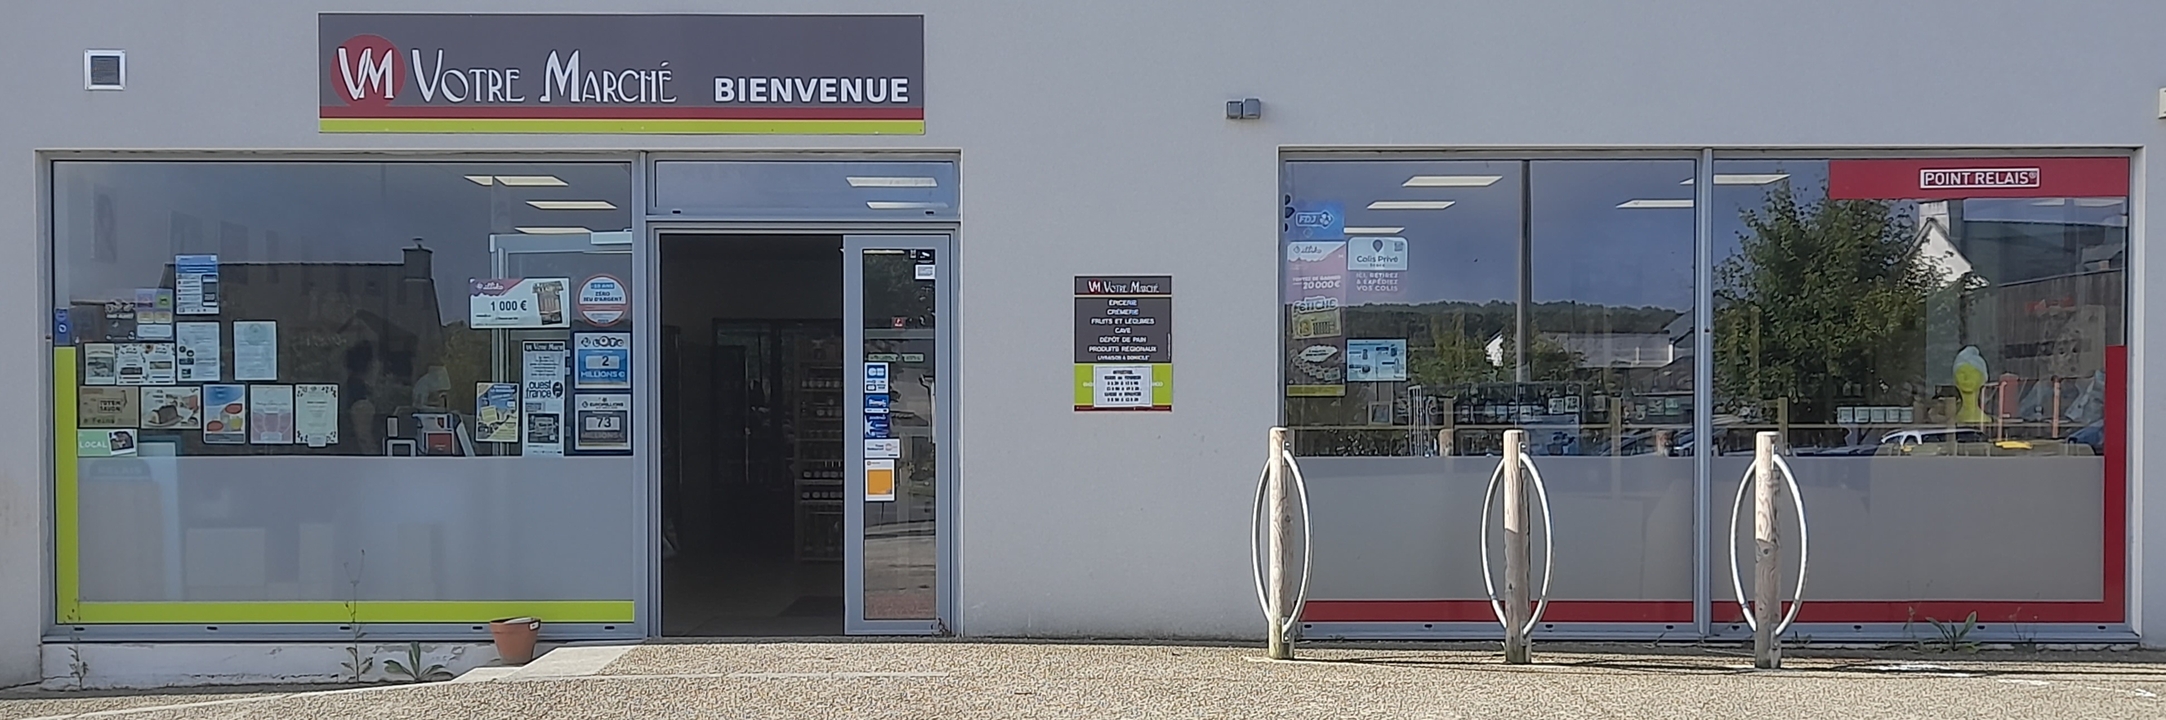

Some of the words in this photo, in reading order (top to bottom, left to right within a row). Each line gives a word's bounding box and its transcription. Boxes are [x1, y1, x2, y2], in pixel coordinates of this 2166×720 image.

[338, 47, 394, 100] VM
[411, 49, 526, 103] VOTRE
[540, 49, 677, 103] MARCHÉ
[714, 77, 909, 102] BIENVENUE
[1925, 172, 1971, 186] POINT
[1299, 215, 1317, 224] FDJ
[1356, 255, 1376, 263] Colis
[1378, 255, 1399, 263] Privé
[602, 355, 610, 367] 2
[528, 380, 552, 389] ouest
[525, 387, 552, 399] france
[597, 416, 612, 428] 73
[79, 441, 108, 449] LOCAL
